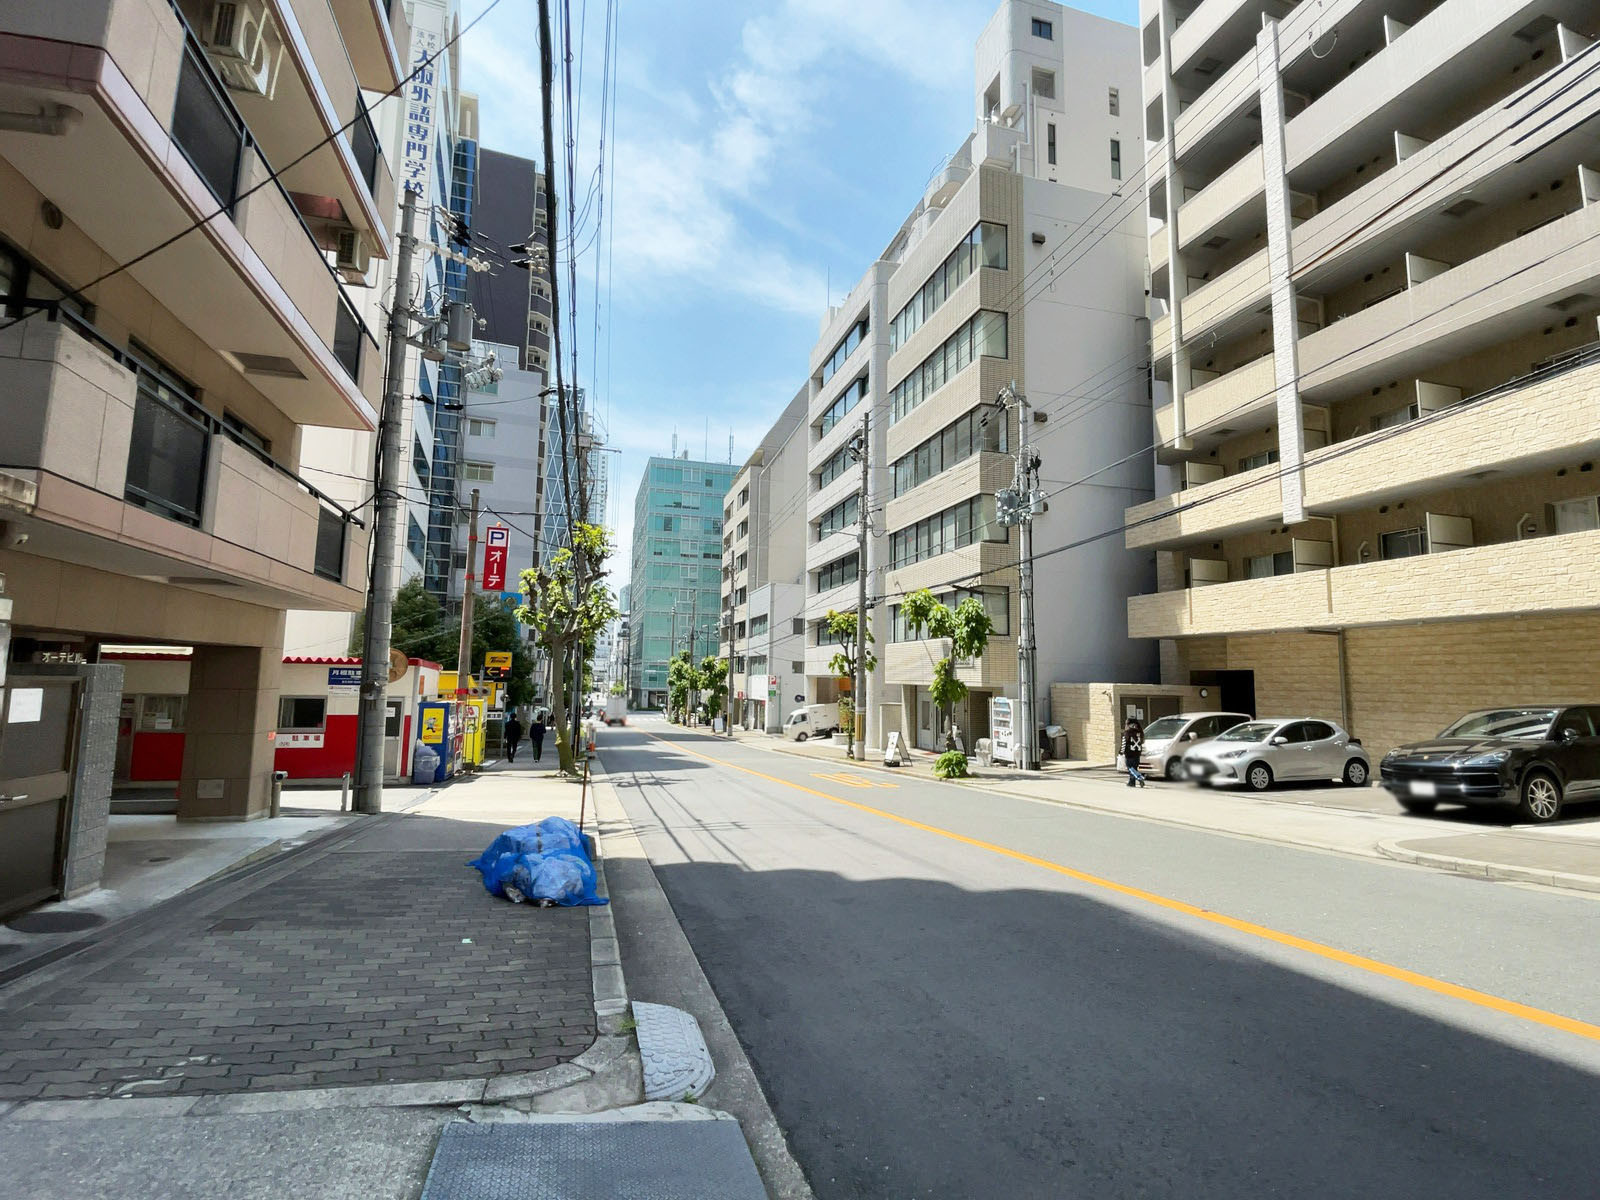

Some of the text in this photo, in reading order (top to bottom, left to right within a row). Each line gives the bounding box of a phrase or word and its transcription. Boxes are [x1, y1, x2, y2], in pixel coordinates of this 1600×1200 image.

[403, 49, 434, 199] 大阪外語専門学校
[490, 531, 504, 544] P
[488, 550, 502, 587] オーテ
